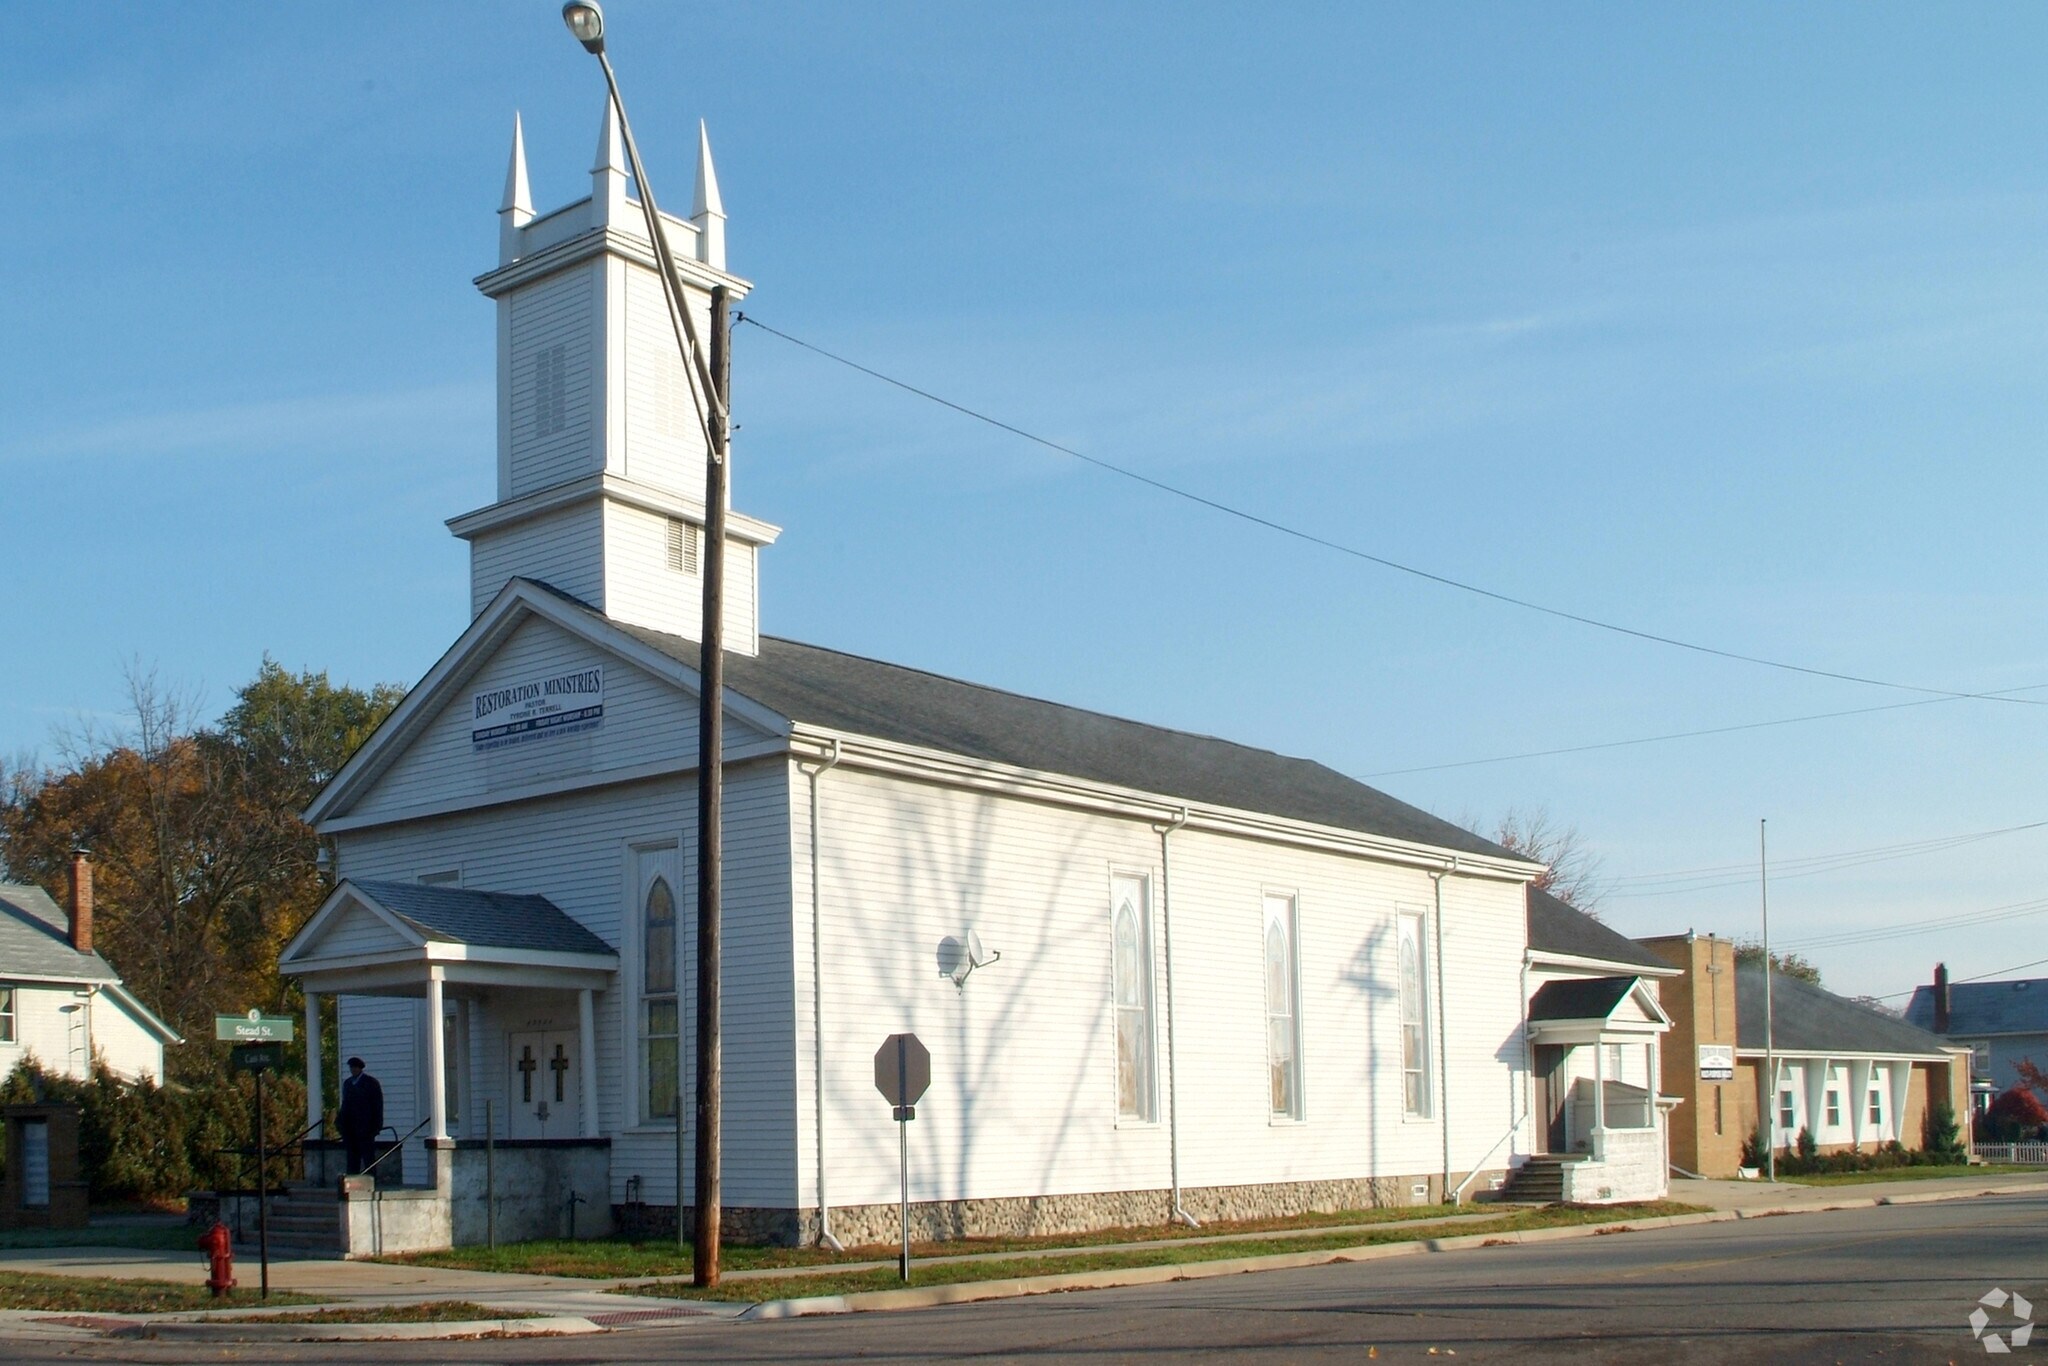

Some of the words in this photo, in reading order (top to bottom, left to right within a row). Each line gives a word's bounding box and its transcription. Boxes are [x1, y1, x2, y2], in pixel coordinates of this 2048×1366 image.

[475, 682, 540, 719] RESTORATION
[544, 669, 600, 695] MINISTRIES
[525, 699, 546, 708] PASTOR
[235, 1025, 260, 1035] Stead
[261, 1026, 273, 1036] St.
